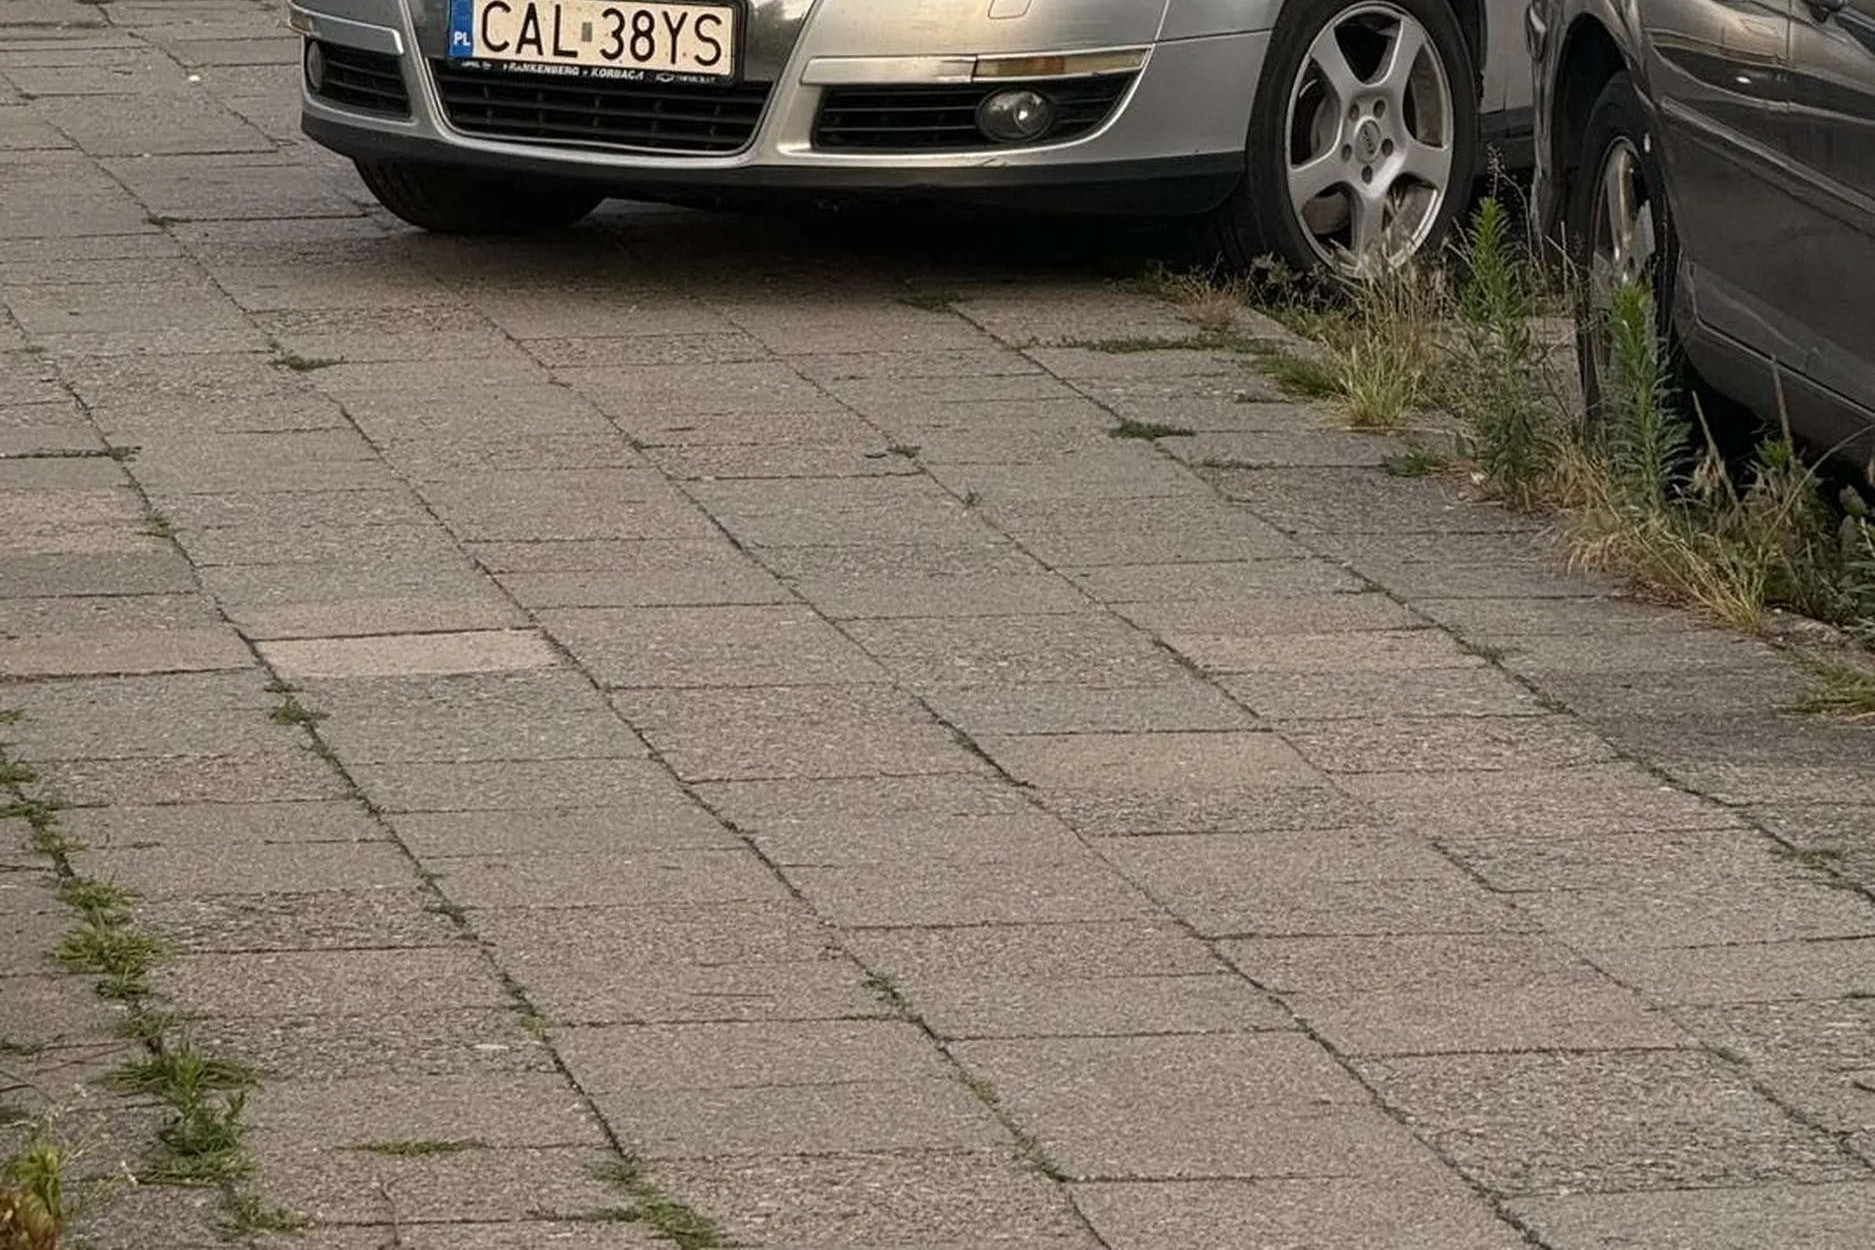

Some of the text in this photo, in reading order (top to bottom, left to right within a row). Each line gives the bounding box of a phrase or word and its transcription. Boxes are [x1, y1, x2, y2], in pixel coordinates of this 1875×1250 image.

[453, 30, 472, 47] PL
[480, 0, 723, 67] CAL 38YS
